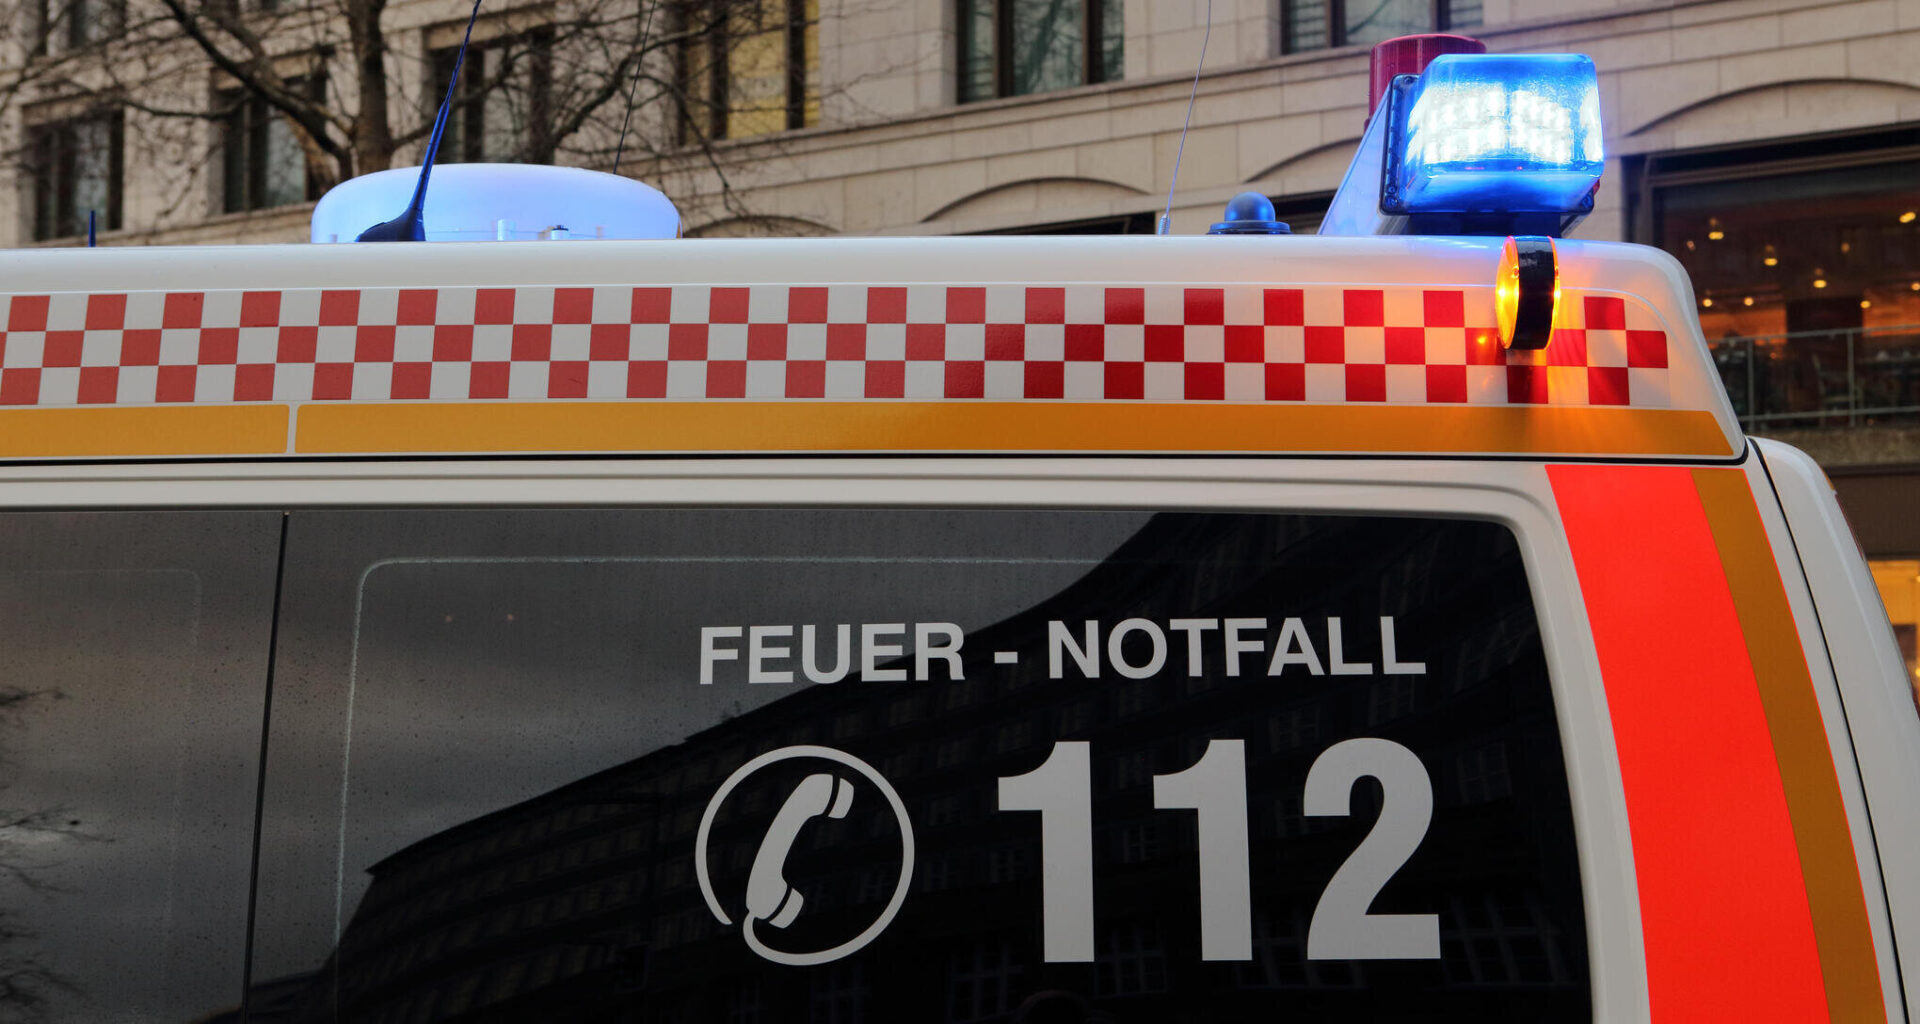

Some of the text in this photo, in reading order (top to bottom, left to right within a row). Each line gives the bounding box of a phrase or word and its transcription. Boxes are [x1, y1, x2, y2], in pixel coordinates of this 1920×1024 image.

[699, 622, 966, 685] FEUER
[1048, 616, 1427, 679] NOTFALL
[998, 737, 1441, 962] 112
